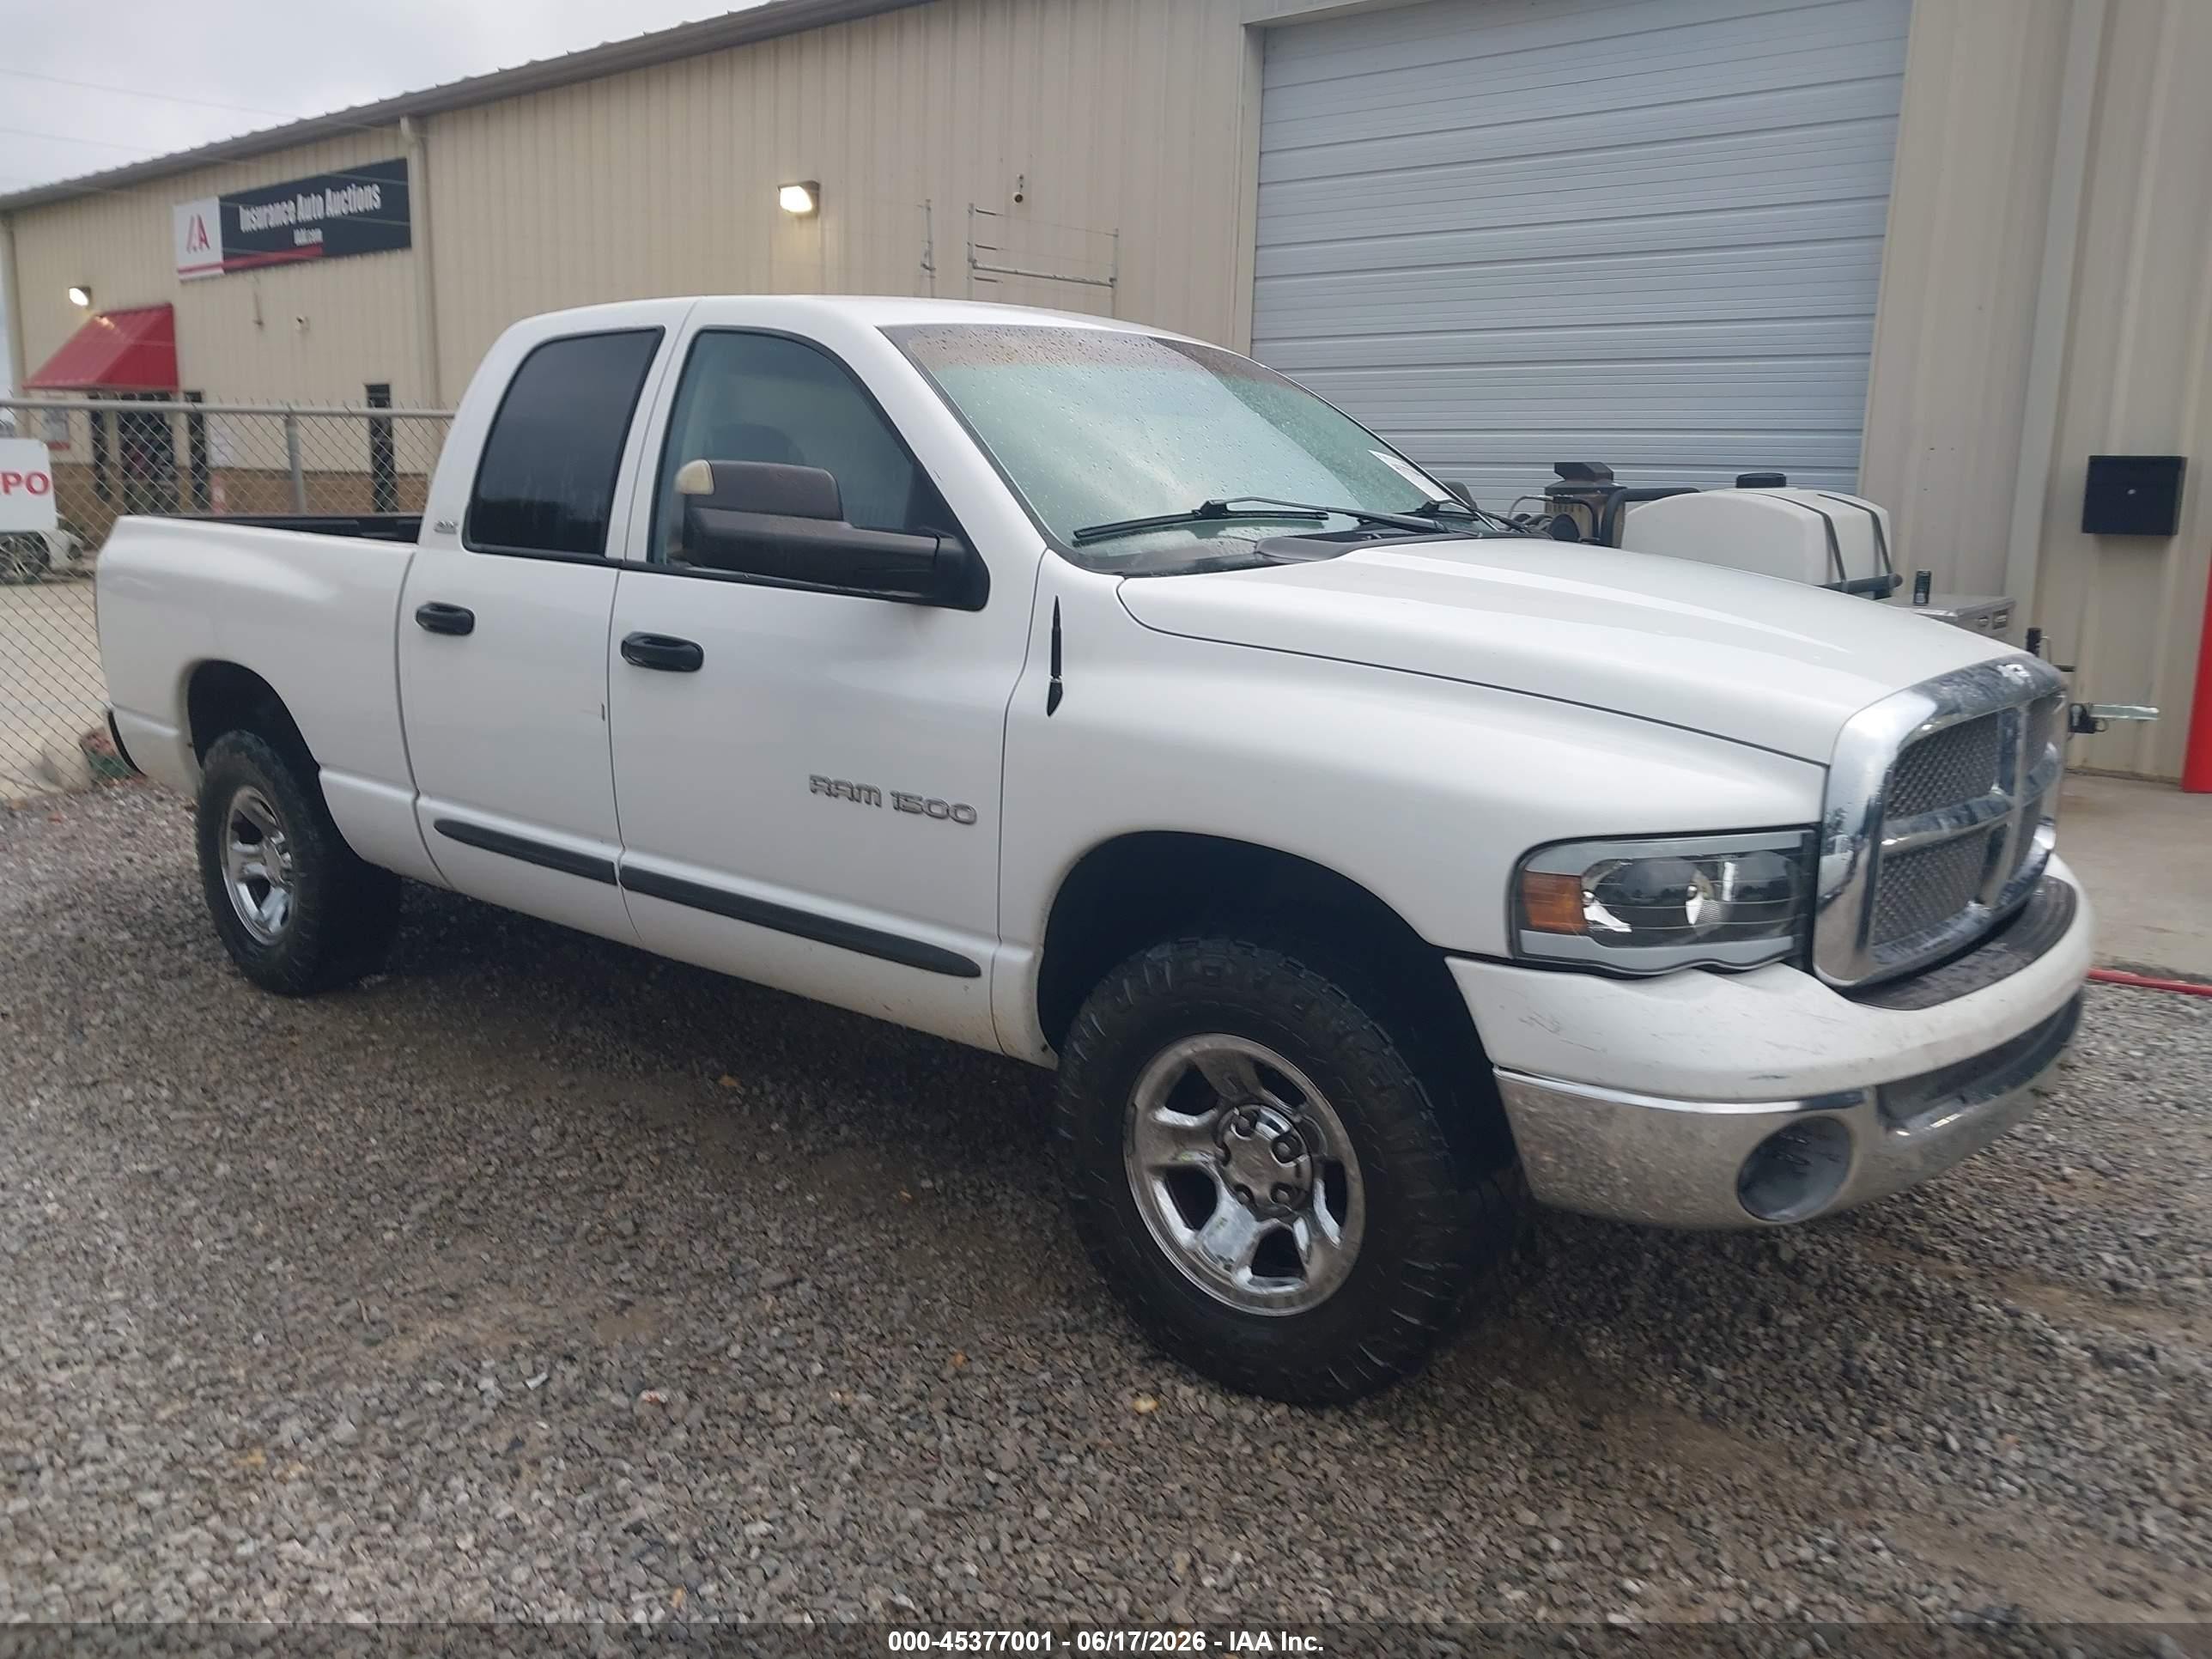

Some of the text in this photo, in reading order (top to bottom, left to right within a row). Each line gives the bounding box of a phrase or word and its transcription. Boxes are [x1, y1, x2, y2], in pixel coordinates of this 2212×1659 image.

[239, 183, 382, 234] Insurance Auto Auctions
[809, 774, 978, 826] RAM 1500
